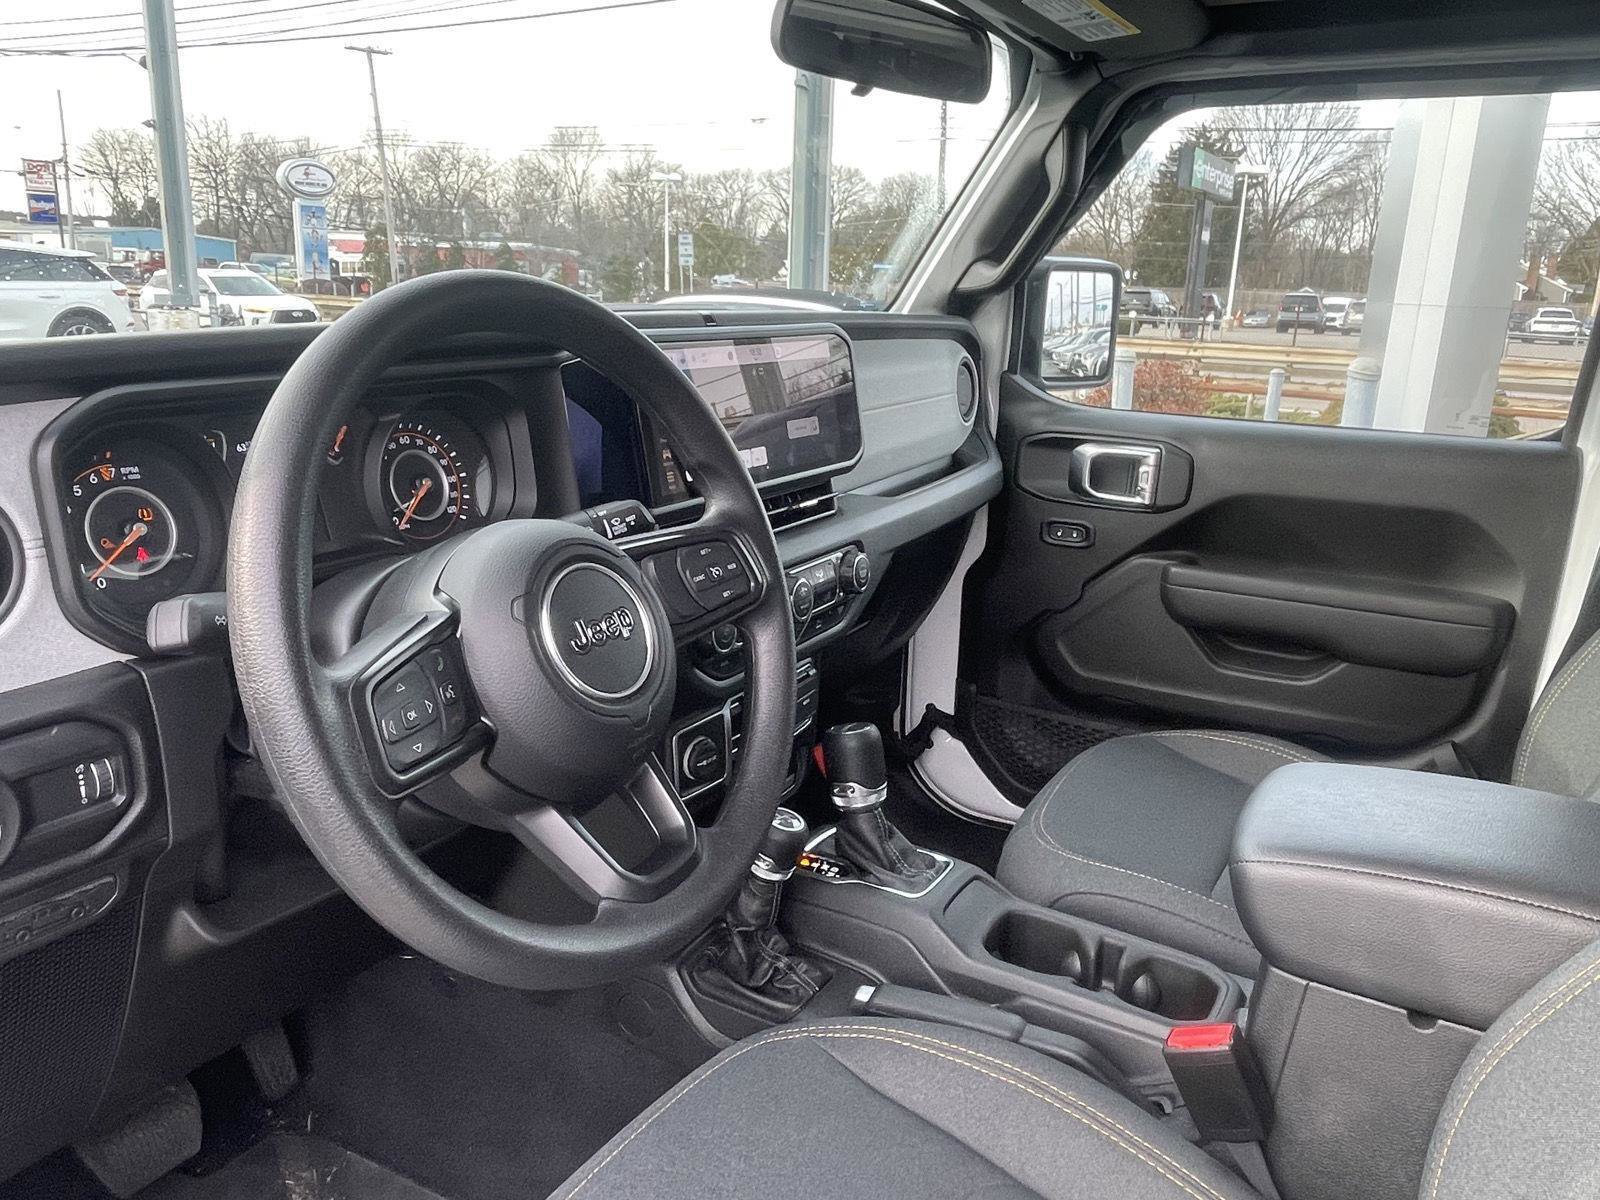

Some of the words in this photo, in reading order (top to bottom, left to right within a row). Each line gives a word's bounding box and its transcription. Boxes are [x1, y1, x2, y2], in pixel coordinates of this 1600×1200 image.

[108, 467, 115, 478] 7
[120, 465, 140, 474] RPM
[90, 473, 98, 483] 6
[73, 485, 82, 496] 5
[97, 577, 106, 589] 0
[569, 606, 634, 654] Jeep
[406, 709, 418, 721] OK
